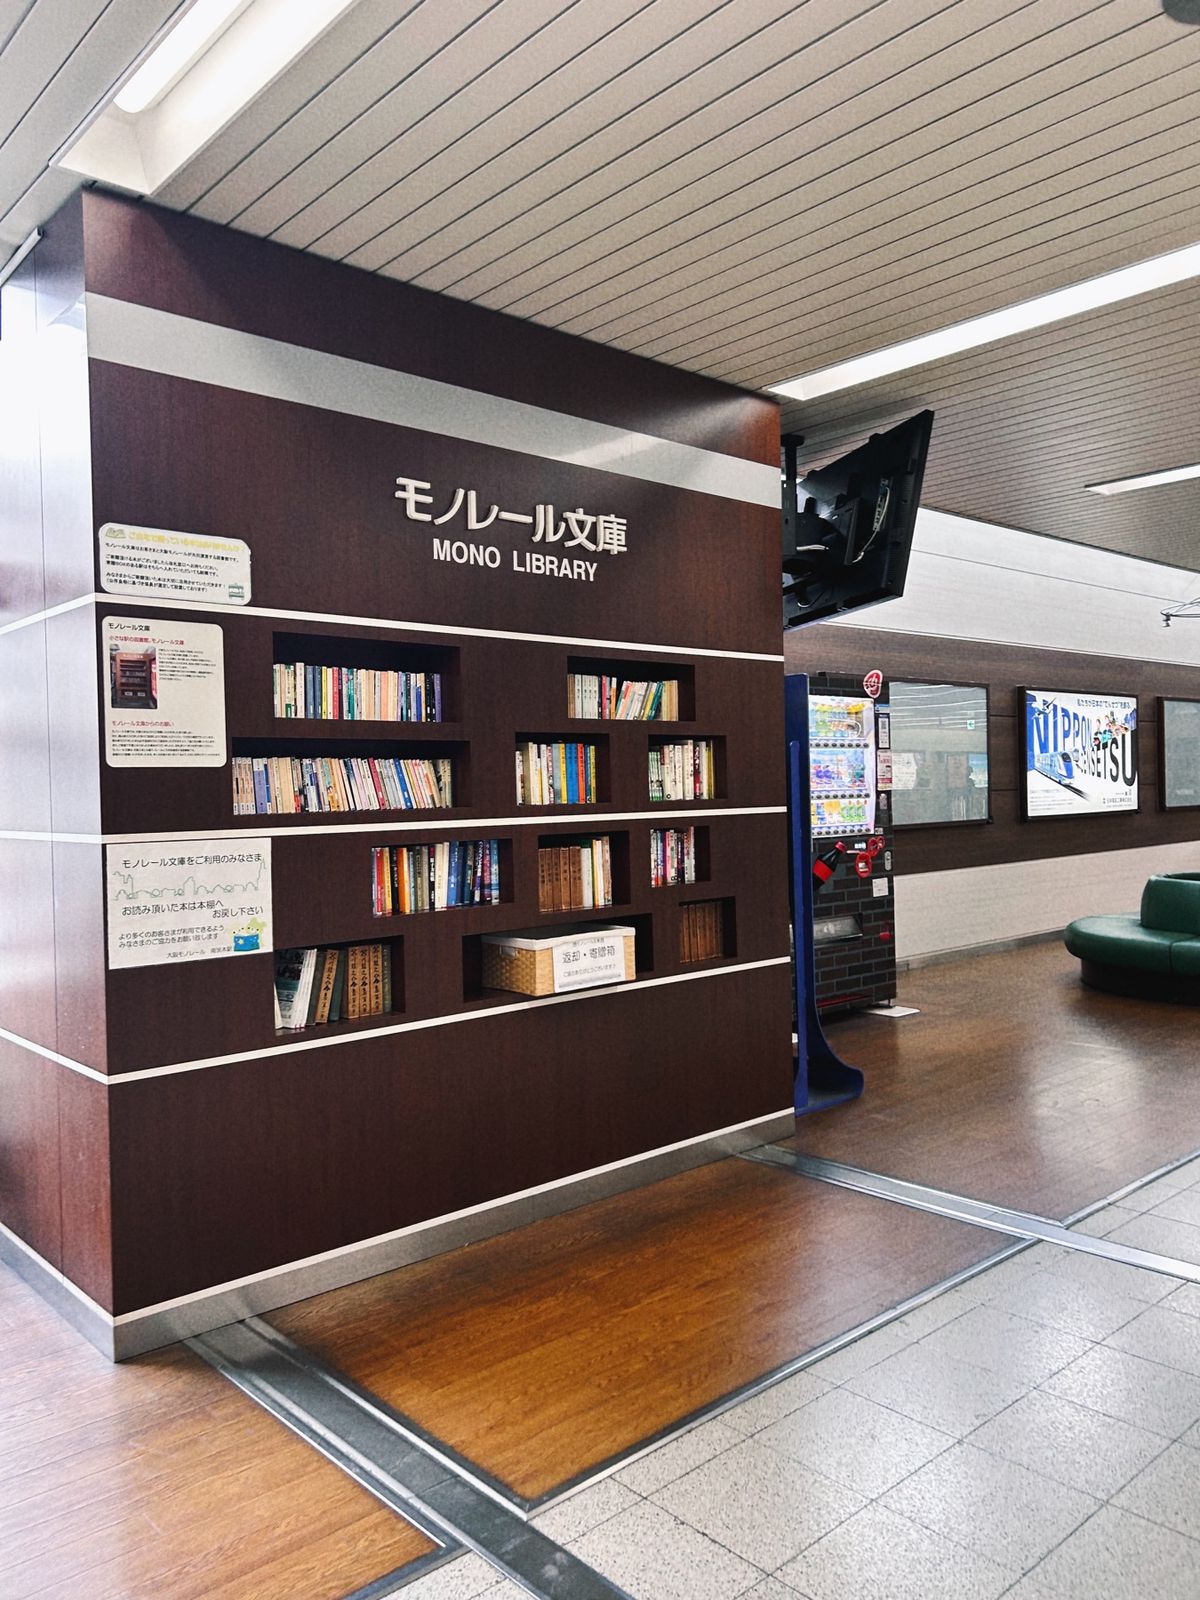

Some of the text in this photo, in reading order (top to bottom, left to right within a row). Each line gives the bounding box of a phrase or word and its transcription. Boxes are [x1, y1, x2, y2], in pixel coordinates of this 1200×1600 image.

[395, 477, 628, 556] モノレール文庫
[433, 538, 598, 582] MONO LIBRARY
[108, 623, 150, 631] モノレール文庫
[122, 853, 262, 869] モノレール文庫をご利用のみなさま
[122, 899, 224, 916] お読み頂いた本は本棚へ
[213, 906, 264, 919] お戻し下さい
[118, 925, 225, 941] より多くのお客さまが利用できるよう
